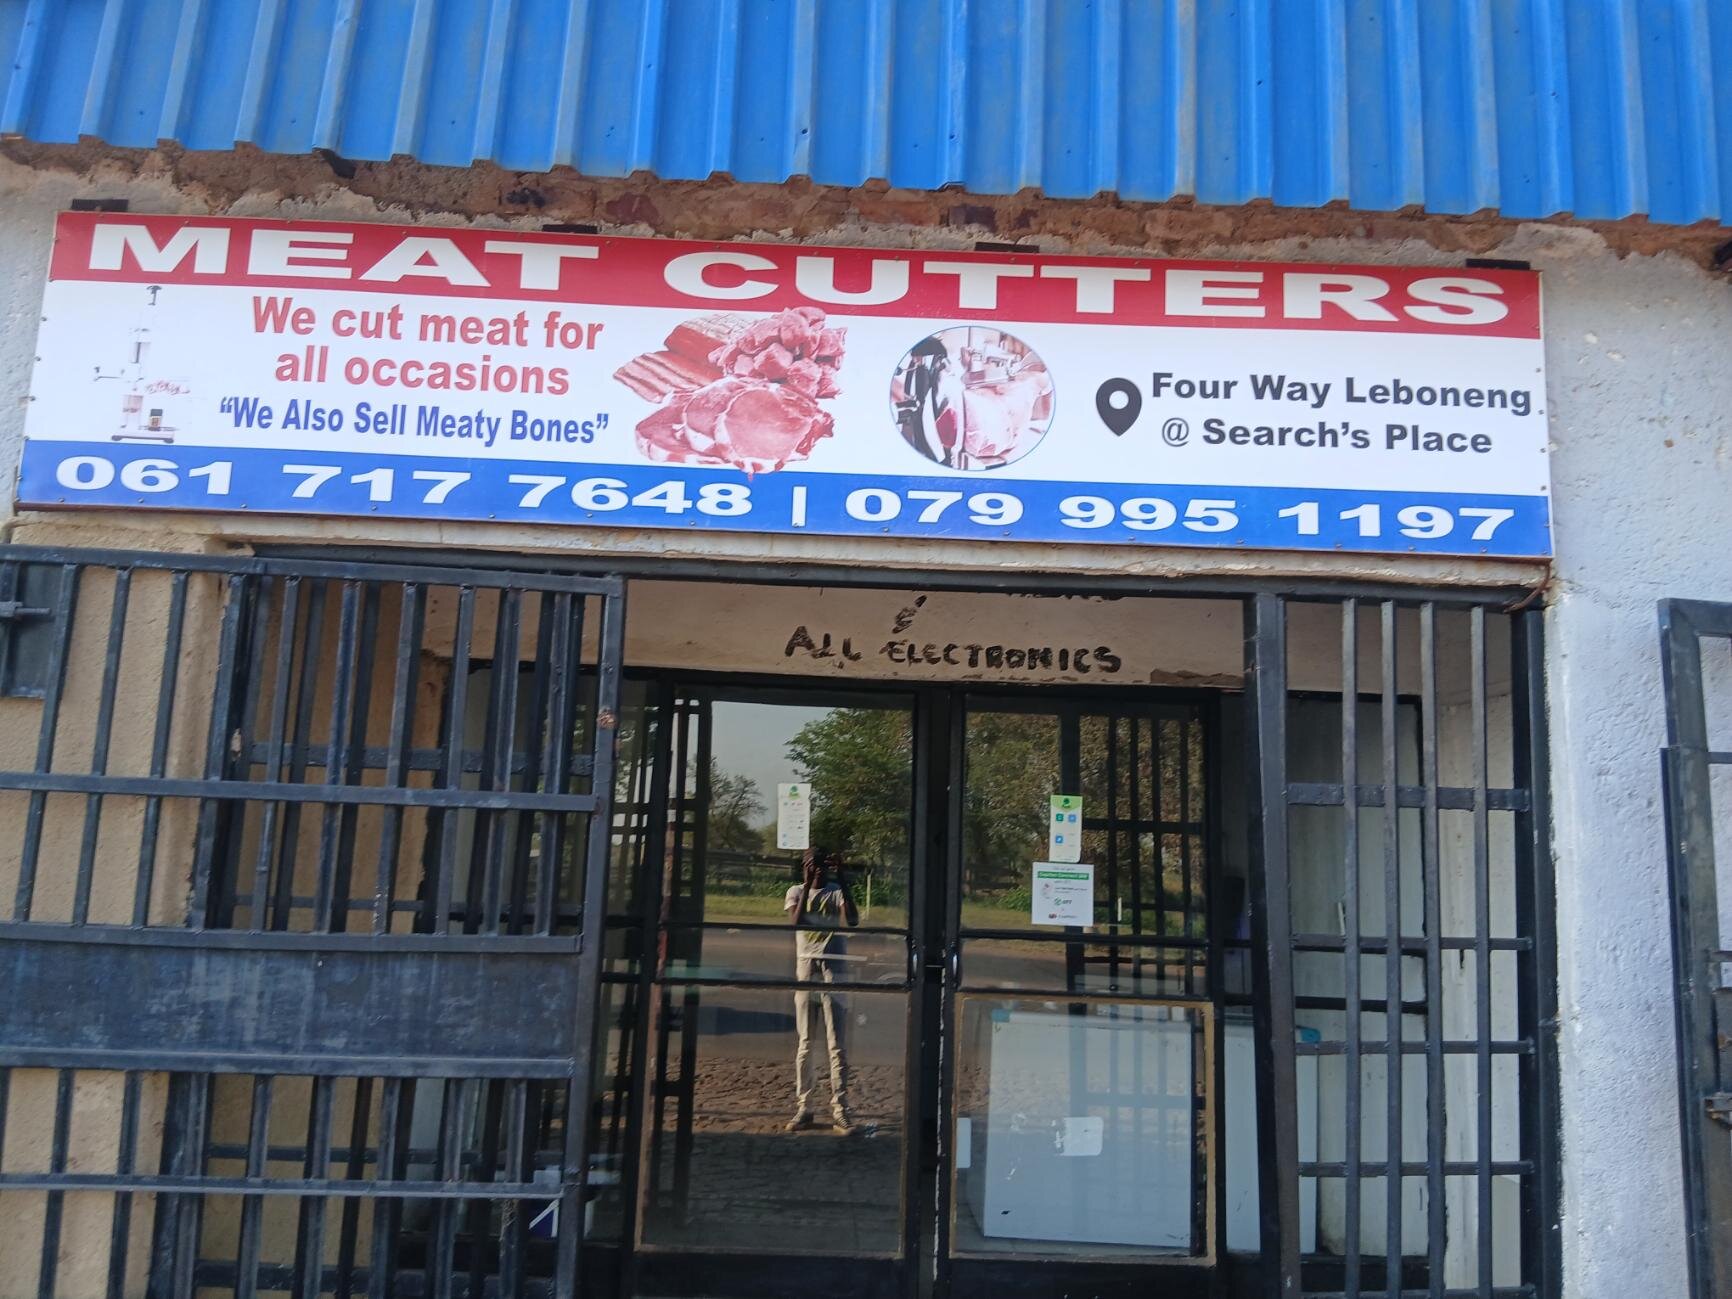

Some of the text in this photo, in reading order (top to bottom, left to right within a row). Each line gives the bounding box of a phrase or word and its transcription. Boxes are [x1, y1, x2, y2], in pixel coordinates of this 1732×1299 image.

[88, 223, 1509, 325] MEAT CUTTERS
[252, 295, 604, 350] We cut meat for
[274, 345, 571, 396] all occasions
[1151, 371, 1533, 417] Four Way Leboneng
[219, 397, 610, 445] “We Also Sell Meaty Bones”
[1161, 417, 1493, 454] @ Search’s Place
[55, 455, 233, 495] 061
[282, 464, 472, 503] 717
[508, 474, 753, 517] 7648
[844, 488, 1025, 527] 079
[1058, 495, 1240, 533] 995
[1278, 501, 1515, 541] 1197
[784, 625, 1122, 674] ALL ELECTRONICS
